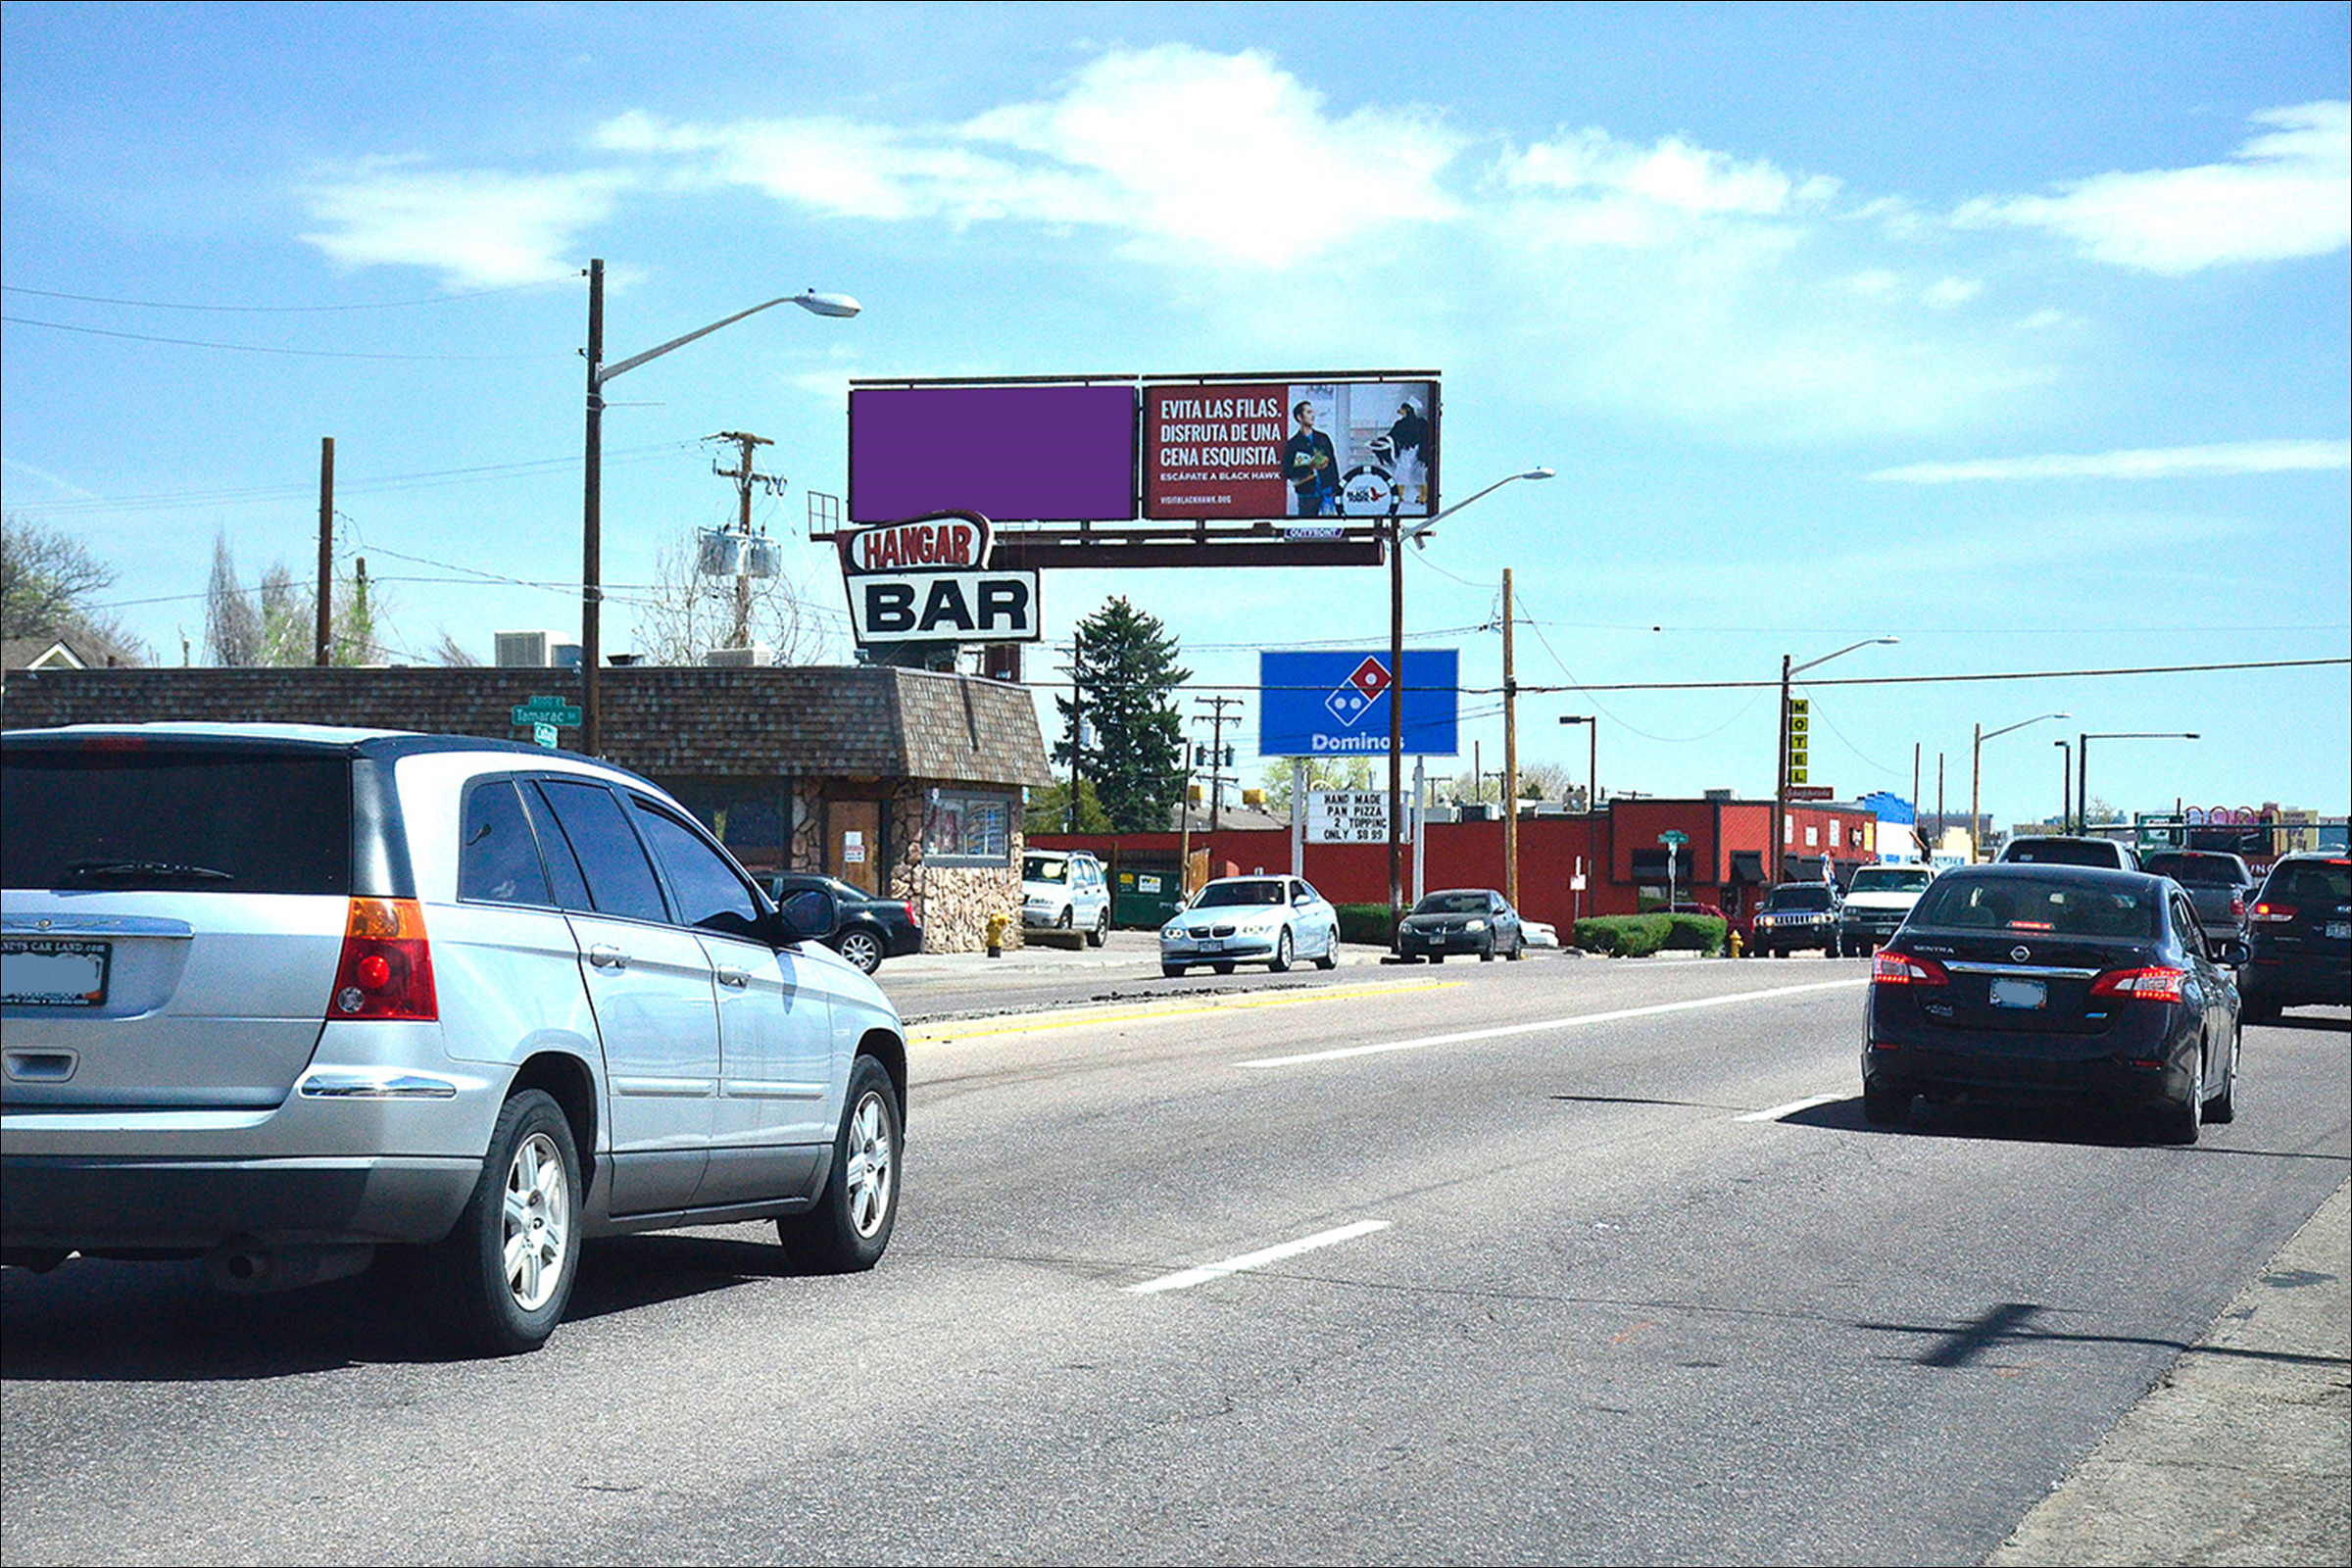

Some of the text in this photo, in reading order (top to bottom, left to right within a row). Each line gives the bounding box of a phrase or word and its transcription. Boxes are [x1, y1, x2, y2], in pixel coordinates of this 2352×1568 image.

[1161, 397, 1282, 419] EVITA LAS FILAS.
[1160, 422, 1281, 443] DISFRUTA DE UNA
[1160, 446, 1281, 467] CENA ESQUISITA.
[1159, 471, 1281, 482] ESCÁPATE A BLACK HAWK
[863, 524, 972, 568] HANGAR
[865, 579, 1029, 632] BAR
[515, 709, 565, 722] Tamarac
[1794, 703, 1805, 782] MOTEL
[1327, 807, 1382, 816] PAN PIZZA
[1334, 817, 1387, 828] 2 TOPPING
[1324, 829, 1349, 840] ONLY
[30, 942, 52, 952] CAR
[1913, 945, 1955, 955] SENTRA
